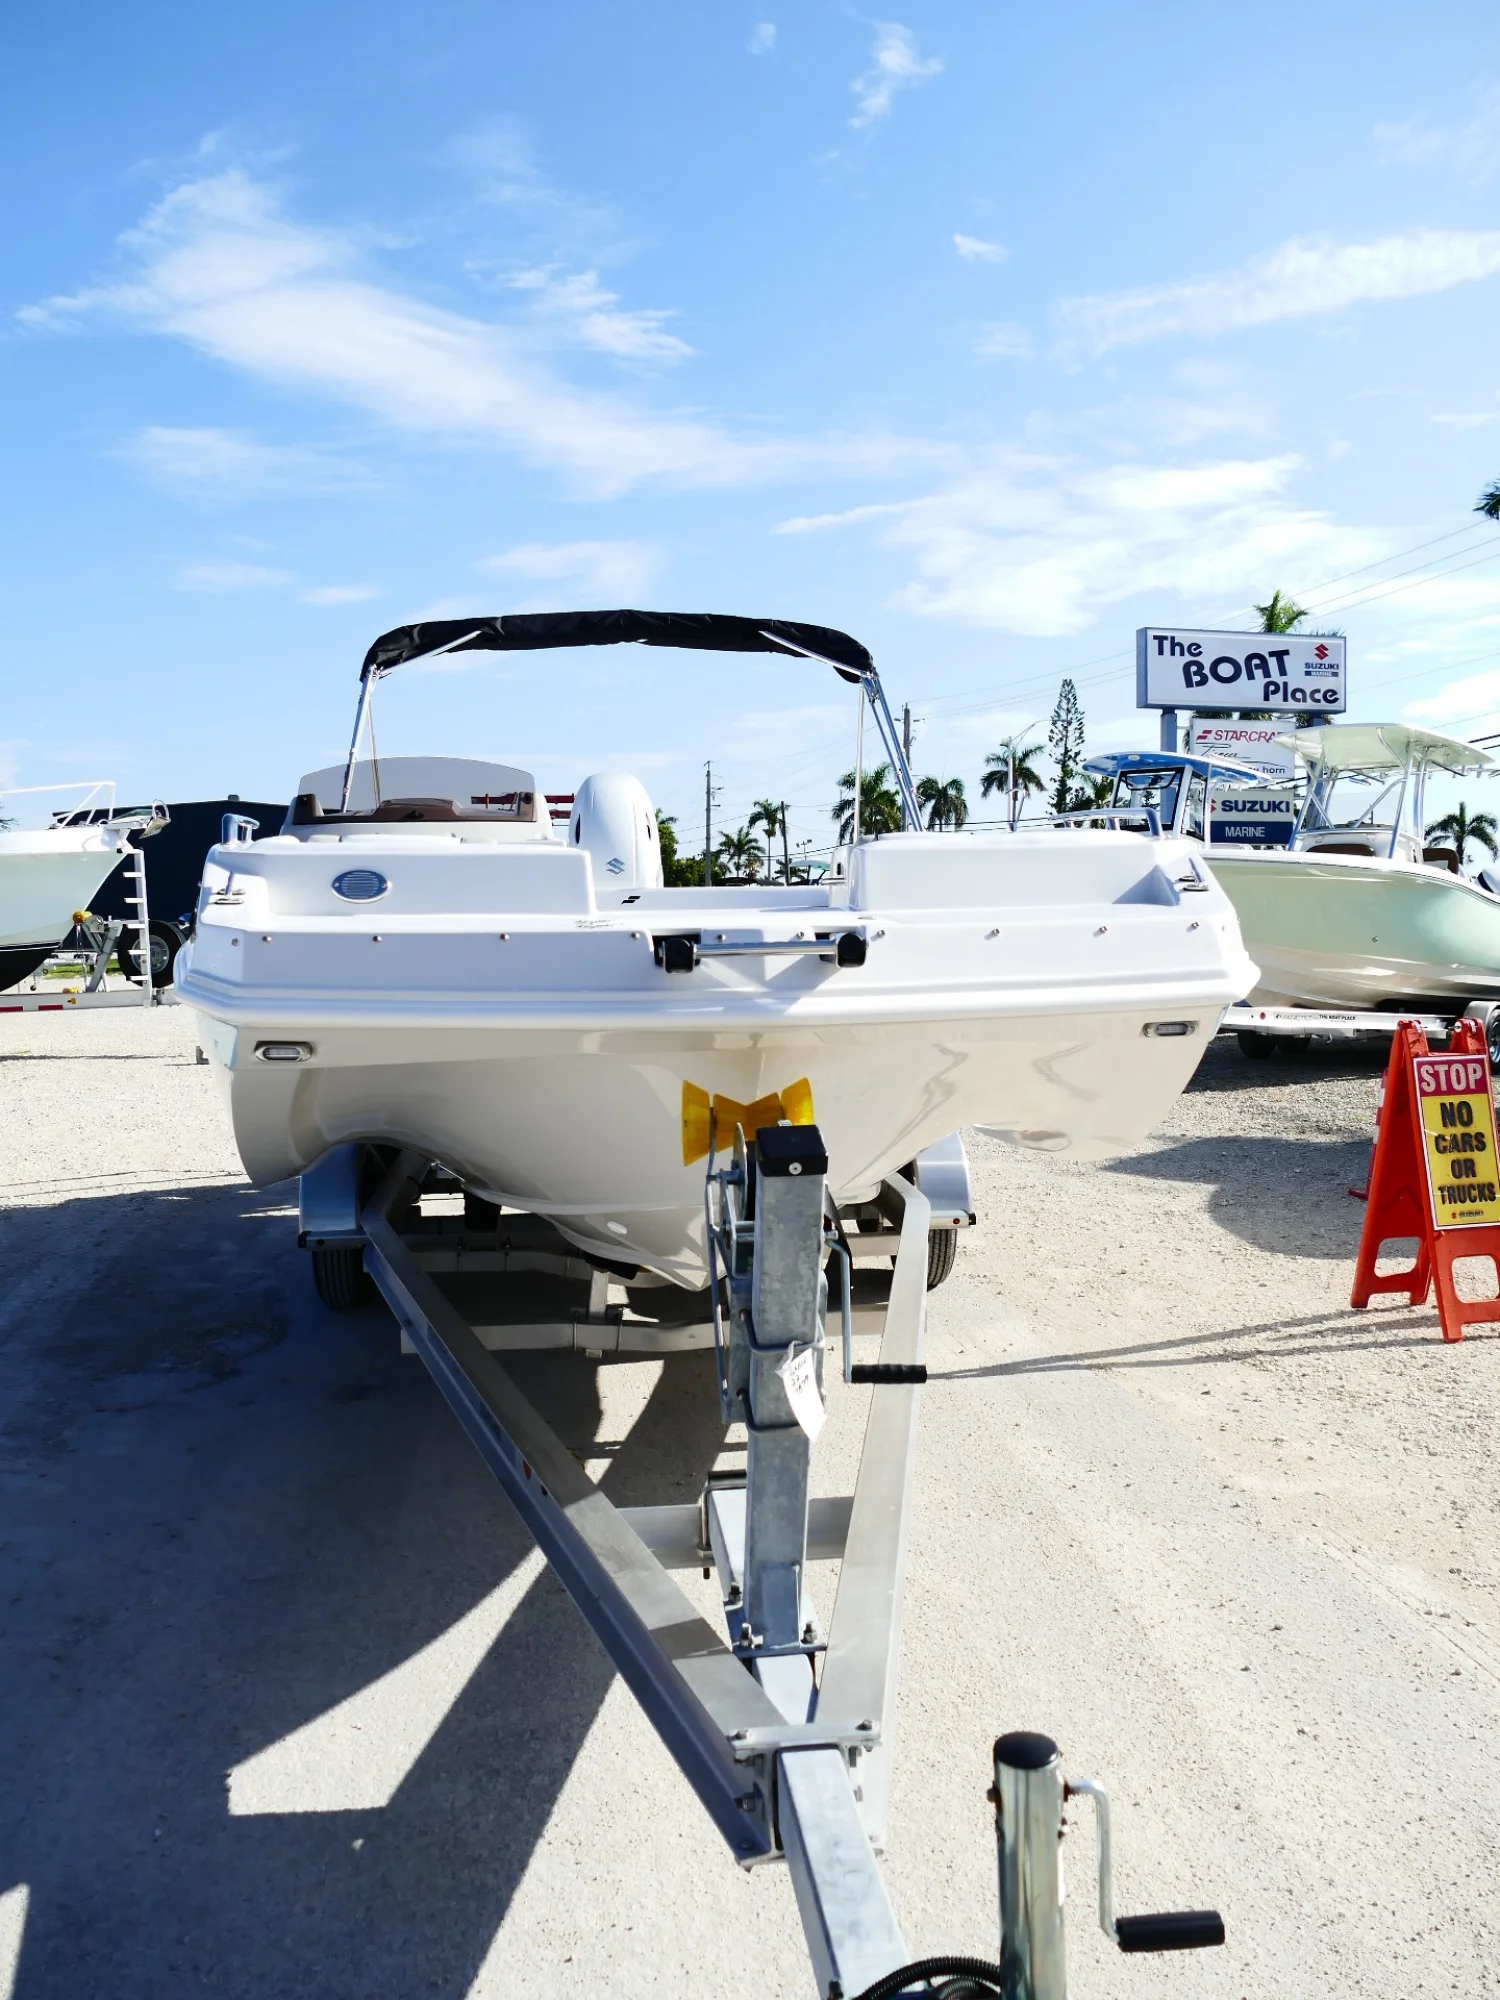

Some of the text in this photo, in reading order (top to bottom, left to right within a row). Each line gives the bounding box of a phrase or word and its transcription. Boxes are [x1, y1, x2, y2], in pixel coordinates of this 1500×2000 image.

[1152, 635, 1203, 657] The
[1182, 649, 1290, 688] BOAT
[1304, 662, 1340, 670] SUZUKI
[1262, 680, 1340, 704] Place
[1214, 729, 1283, 743] STARCRA
[1262, 766, 1286, 774] horn
[1221, 800, 1290, 813] SUZUKI
[1225, 826, 1266, 838] MARINE
[1420, 1063, 1483, 1093] STOP
[1440, 1101, 1473, 1128] NO
[1435, 1131, 1487, 1154] CARS
[1450, 1158, 1477, 1179] OR
[1438, 1181, 1497, 1205] TRUCKS
